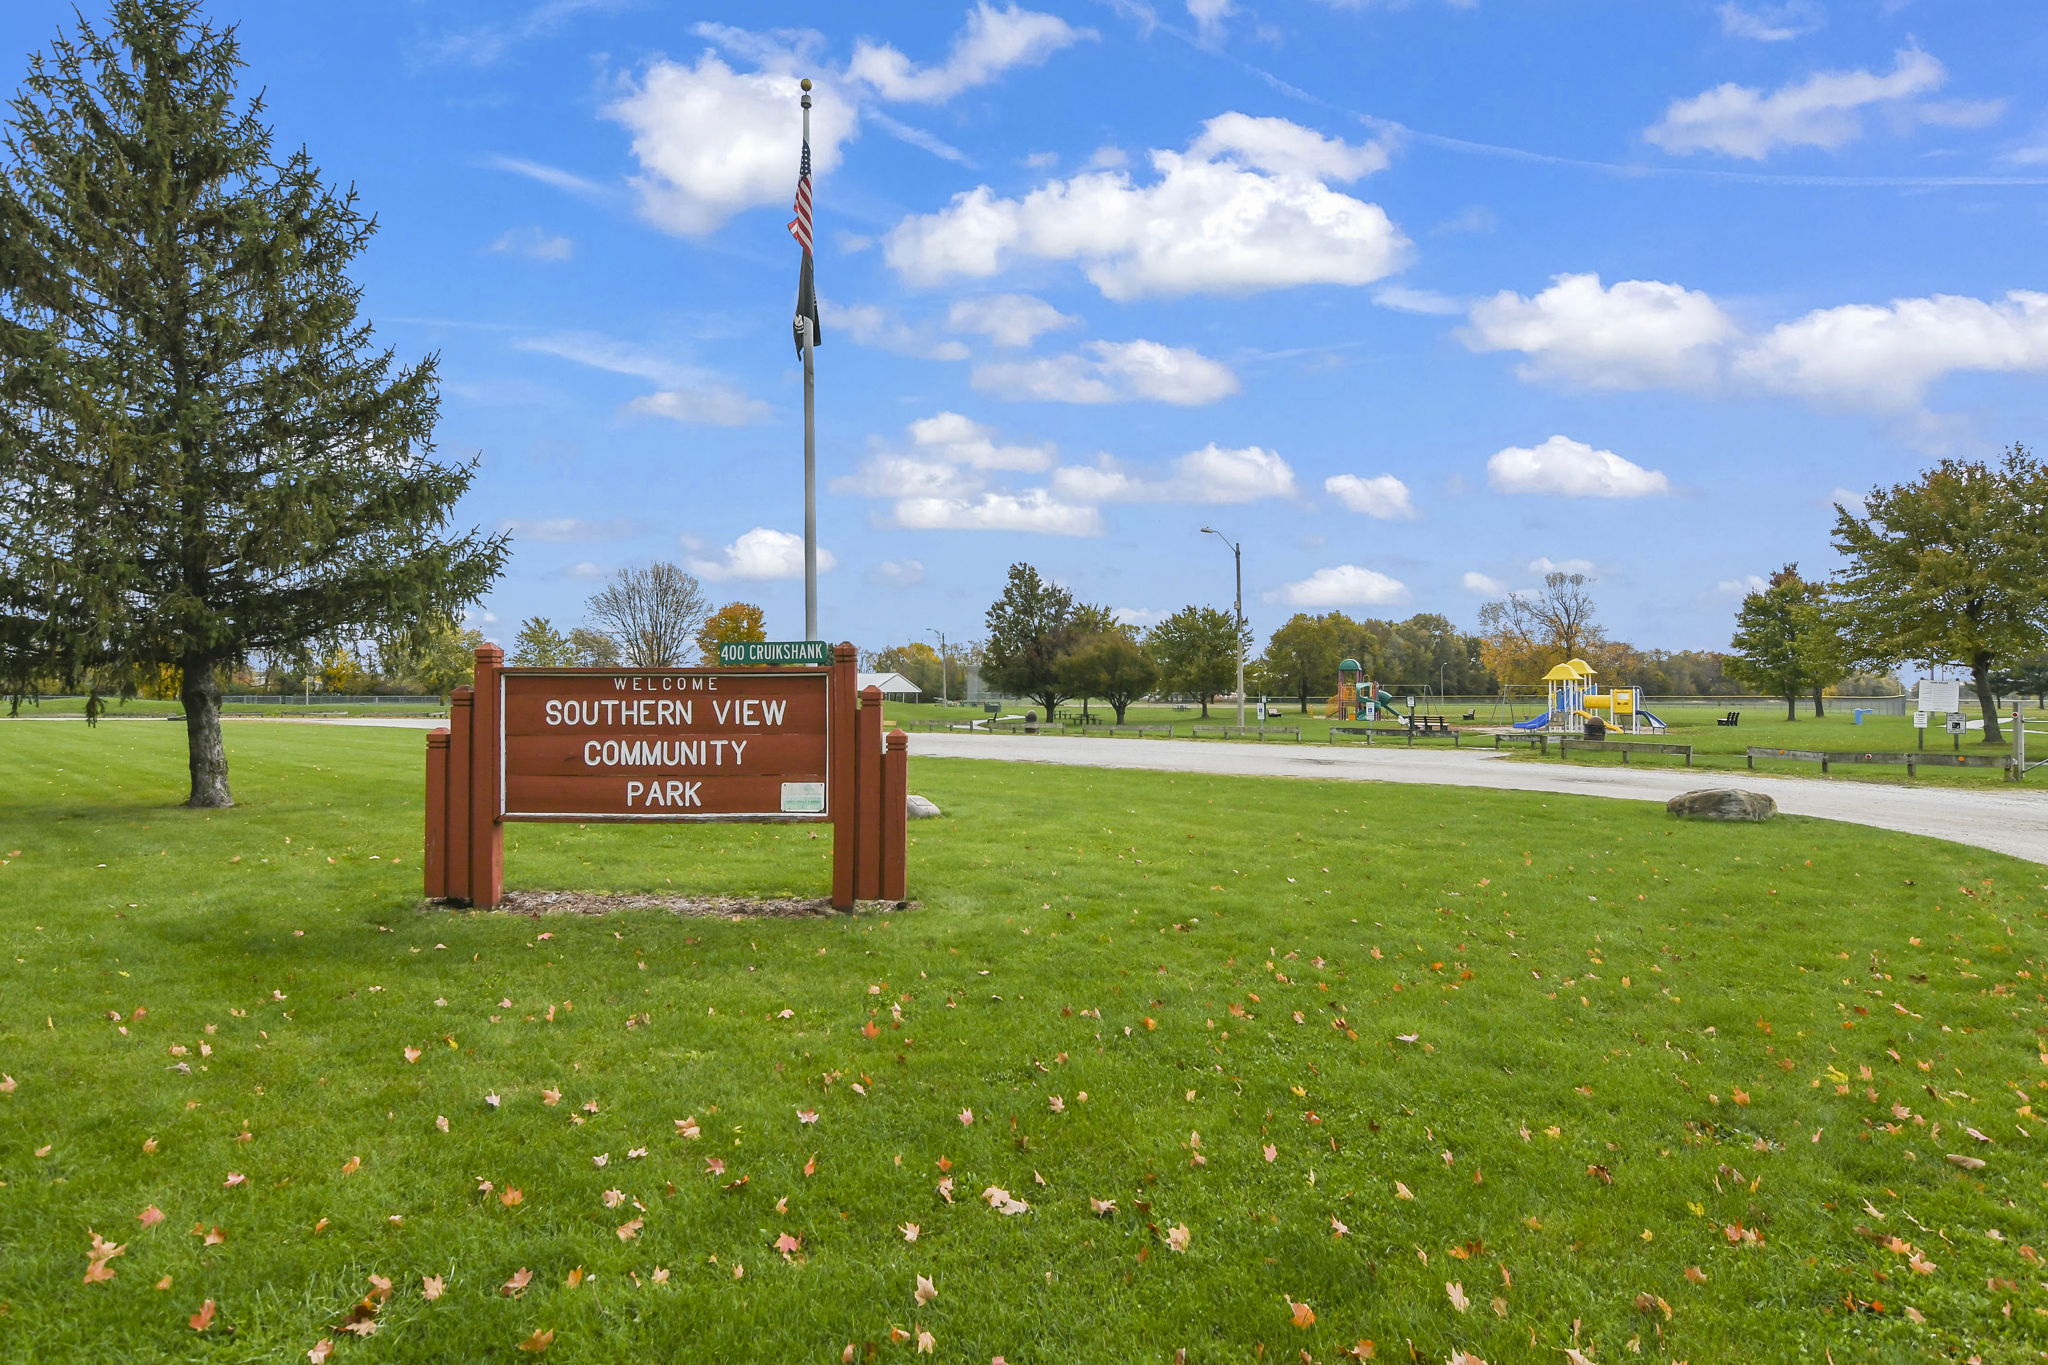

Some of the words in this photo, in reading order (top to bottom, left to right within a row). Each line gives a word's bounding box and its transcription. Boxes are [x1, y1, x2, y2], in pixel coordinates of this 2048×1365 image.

[721, 645, 745, 661] 400
[749, 643, 823, 660] CRUIKSHANK
[614, 677, 718, 691] WELCOME
[545, 699, 692, 726] SOUTHERN
[713, 699, 786, 726] VIEW
[584, 739, 748, 766] COMMUNITY
[627, 780, 702, 807] PARK
